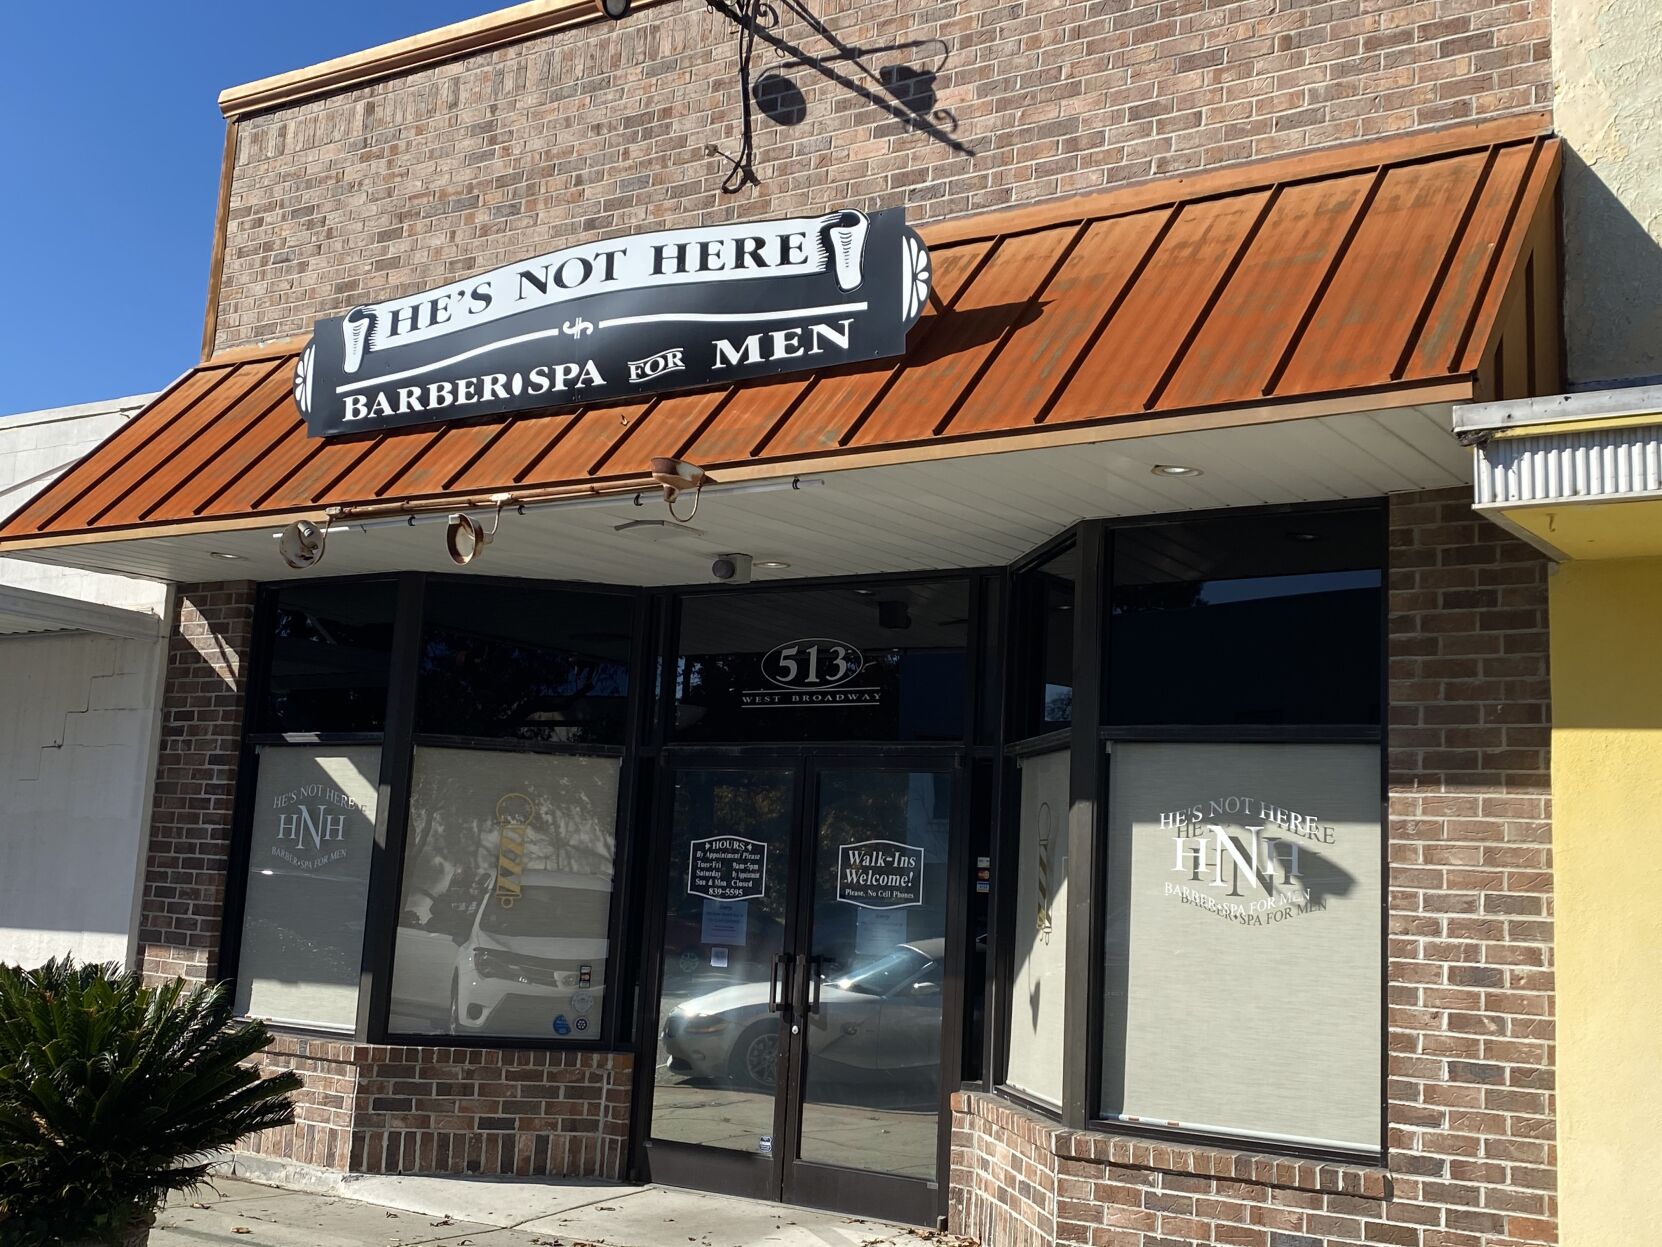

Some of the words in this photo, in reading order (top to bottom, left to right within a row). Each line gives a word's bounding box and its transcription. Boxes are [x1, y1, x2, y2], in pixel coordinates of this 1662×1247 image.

[515, 247, 628, 302] NOT
[649, 231, 809, 276] HERE
[628, 350, 684, 381] FOR
[711, 318, 854, 370] MEN
[775, 645, 848, 683] 513
[742, 695, 781, 703] WEST
[792, 692, 882, 702] BROADWAY
[300, 783, 323, 799] NOT
[326, 787, 357, 810] HERE
[1209, 796, 1254, 817] NOT
[1259, 801, 1321, 835] HERE
[276, 805, 346, 850] HNH
[712, 840, 746, 850] HOURS
[314, 855, 329, 868] FOR
[330, 848, 347, 861] MEN
[848, 850, 917, 868] Walk-Ins
[1170, 825, 1305, 889] HNH
[696, 870, 721, 878] Saturday
[731, 879, 753, 887] Closed
[845, 868, 914, 887] Welcome!
[708, 888, 744, 897] 839-5595
[867, 889, 877, 897] No
[878, 890, 891, 898] Cell
[893, 890, 914, 899] Phones
[1249, 894, 1277, 914] FOR
[1279, 888, 1312, 904] MEN
